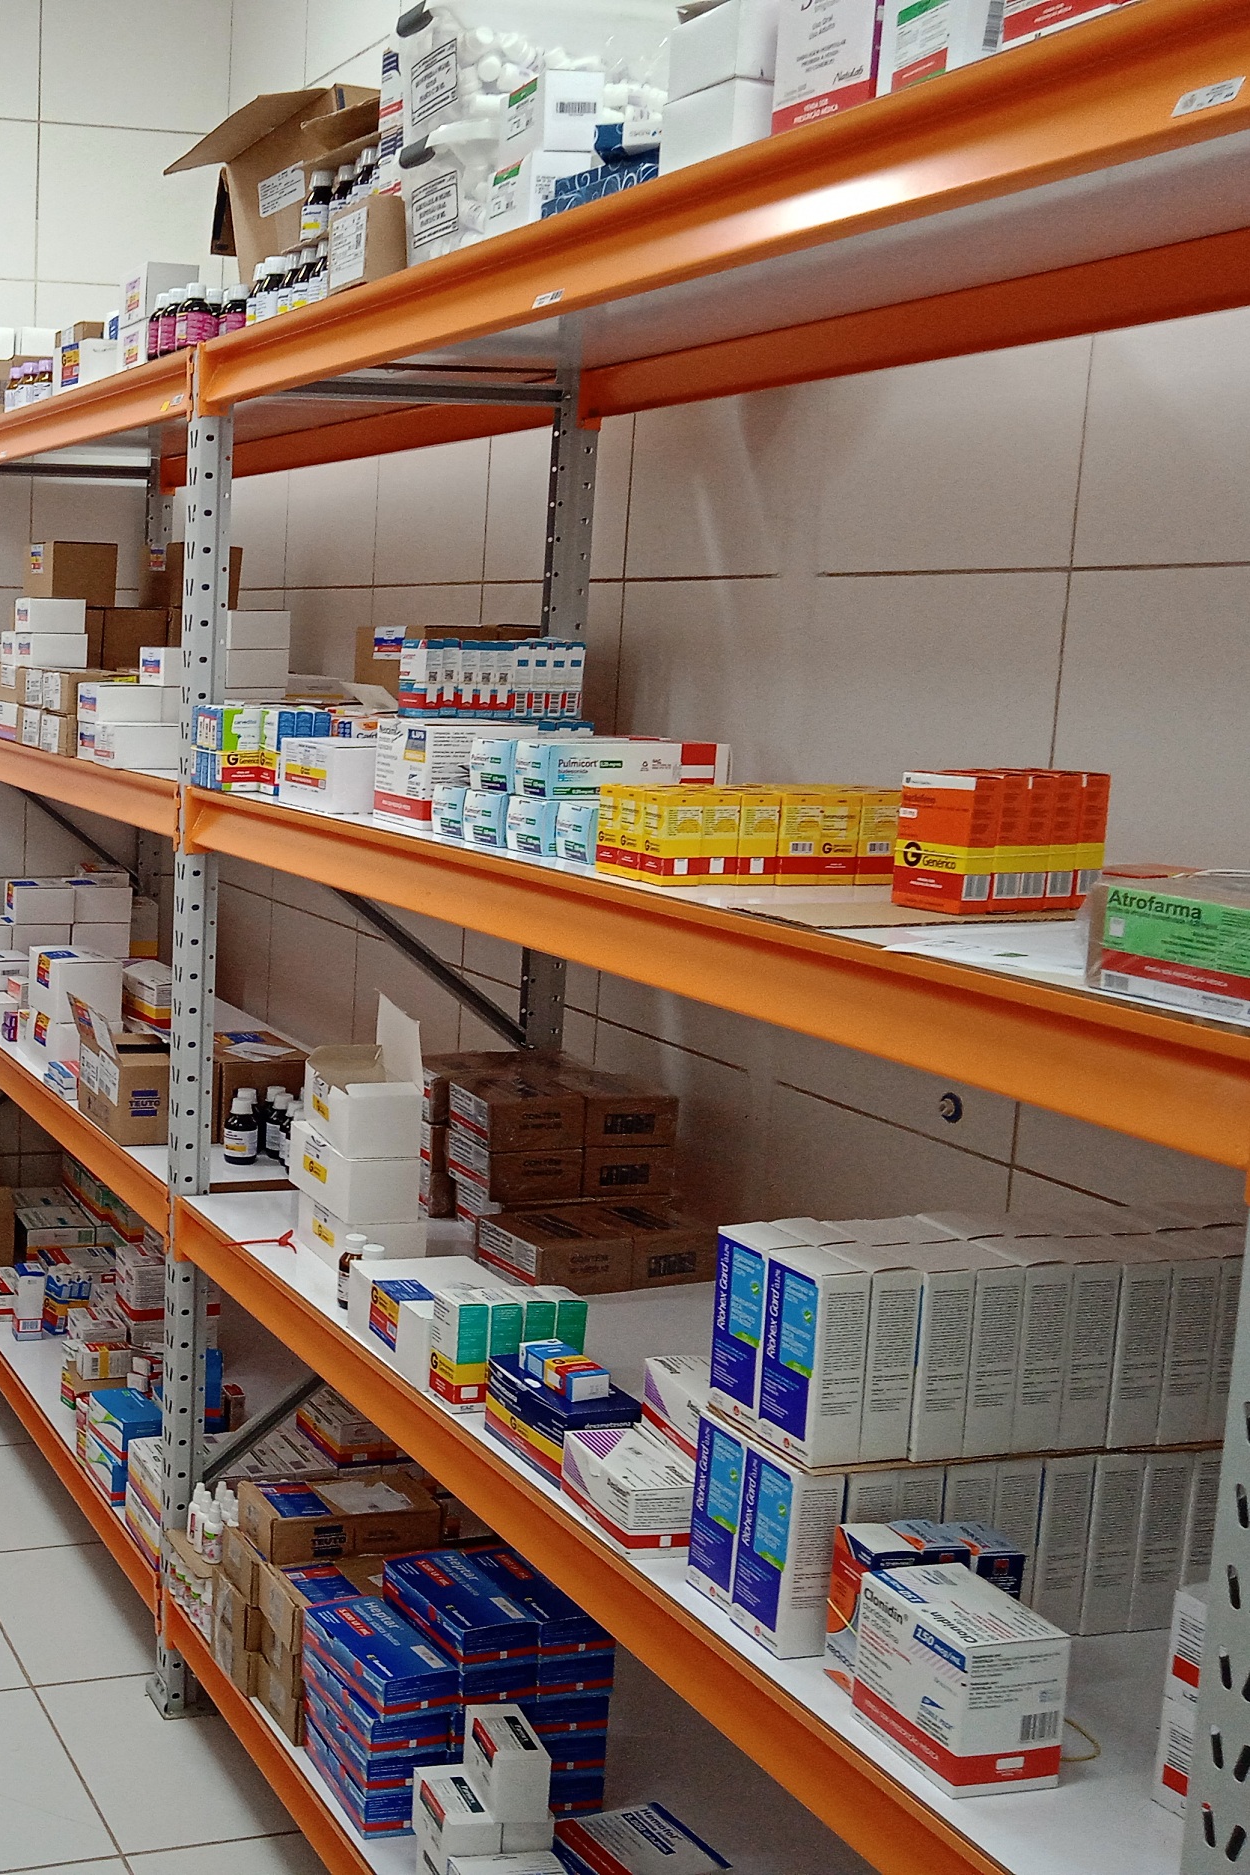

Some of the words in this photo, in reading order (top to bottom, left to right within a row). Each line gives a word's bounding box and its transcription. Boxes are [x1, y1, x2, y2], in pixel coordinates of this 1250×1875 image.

[557, 758, 598, 769] Pulmicort
[903, 841, 922, 867] G
[922, 856, 957, 870] Genérico
[1108, 889, 1203, 920] Atrofarma
[584, 1421, 632, 1430] dexametasona
[444, 1555, 480, 1581] Heptar
[364, 1601, 401, 1629] Heptar
[864, 1587, 904, 1625] Clonidin
[915, 1627, 934, 1645] 150
[931, 1611, 978, 1643] Clonidin
